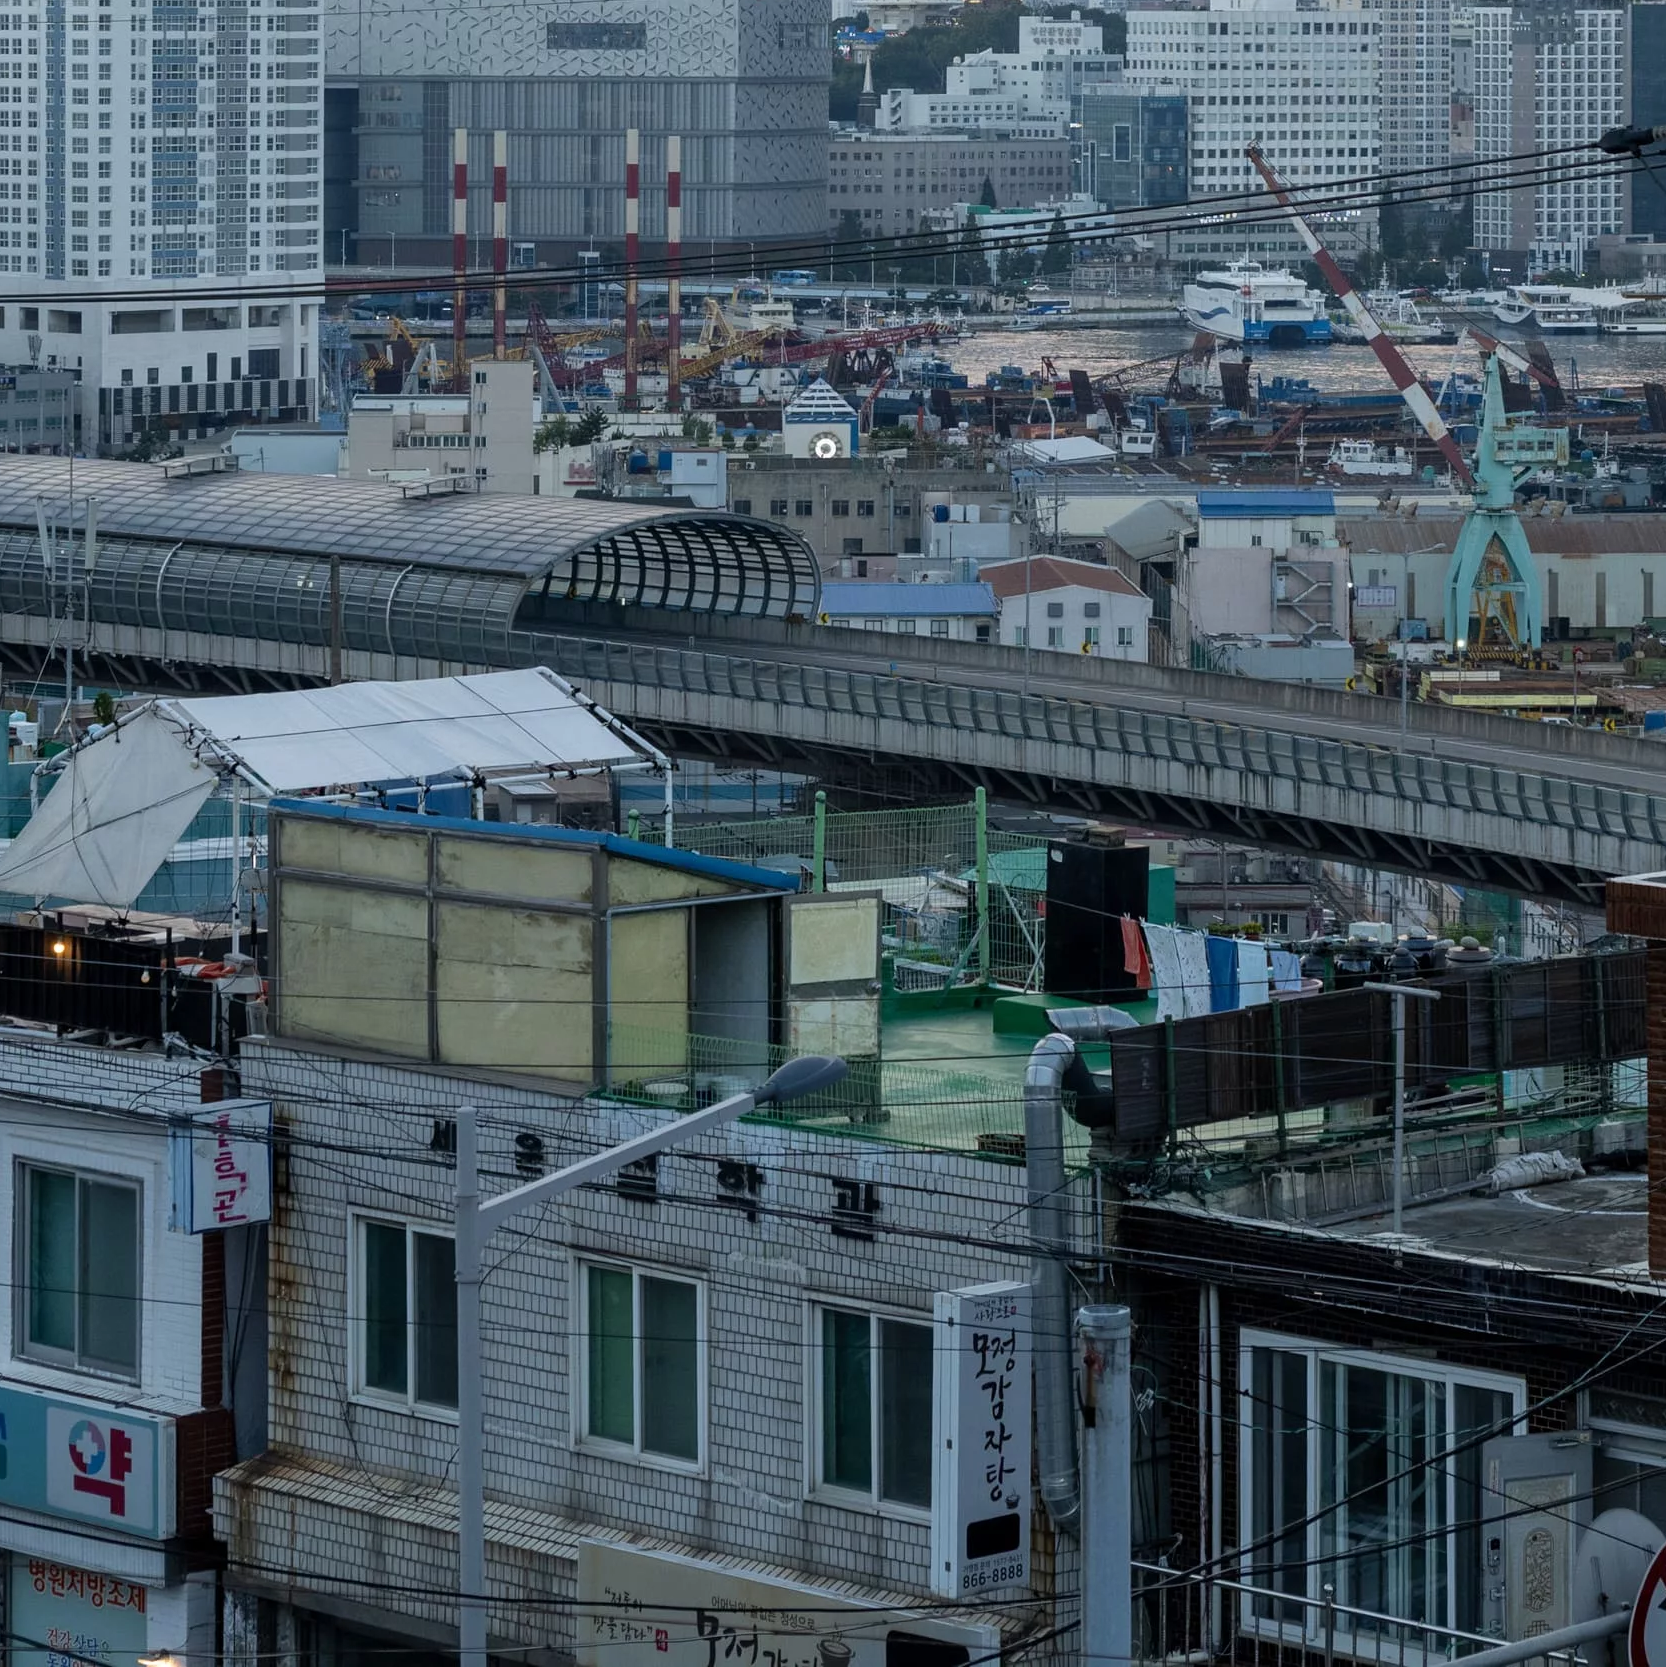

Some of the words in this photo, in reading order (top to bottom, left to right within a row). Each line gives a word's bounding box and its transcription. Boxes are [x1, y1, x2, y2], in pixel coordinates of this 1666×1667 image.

[67, 1419, 131, 1518] 약
[981, 1374, 1016, 1502] 감자탕
[28, 1559, 147, 1614] 병원처방조제
[962, 1563, 1023, 1590] 866-8888
